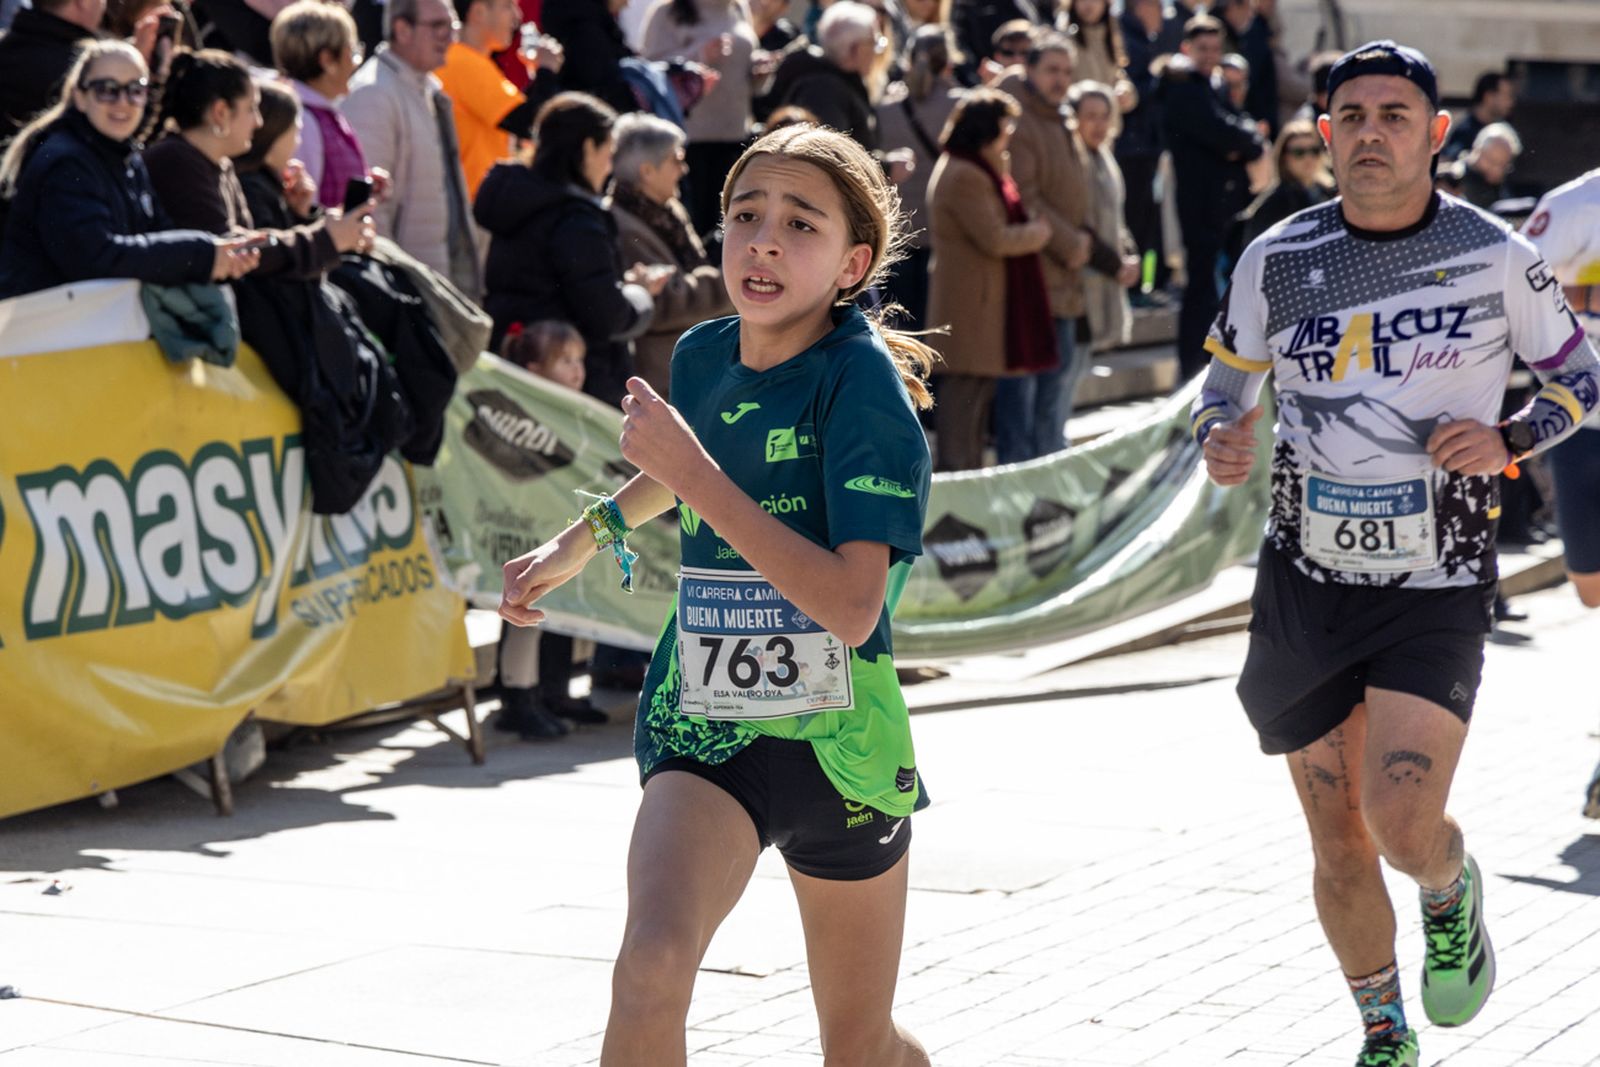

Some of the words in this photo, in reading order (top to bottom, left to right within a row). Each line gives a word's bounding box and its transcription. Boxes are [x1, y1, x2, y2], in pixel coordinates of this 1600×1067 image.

[1279, 306, 1472, 359] JABALCUZ
[1292, 338, 1404, 382] TRAIL
[1400, 343, 1466, 386] Jaén
[1317, 495, 1348, 514] BUENA
[1350, 500, 1395, 516] MUERTE
[1334, 519, 1396, 551] 681
[687, 585, 695, 598] VI
[695, 586, 742, 600] CARRERA
[686, 606, 721, 628] BUENA
[724, 608, 784, 629] MUERTE
[699, 636, 800, 689] 763
[713, 690, 730, 698] ELSA
[732, 690, 763, 699] VALERO
[764, 690, 783, 698] OYA
